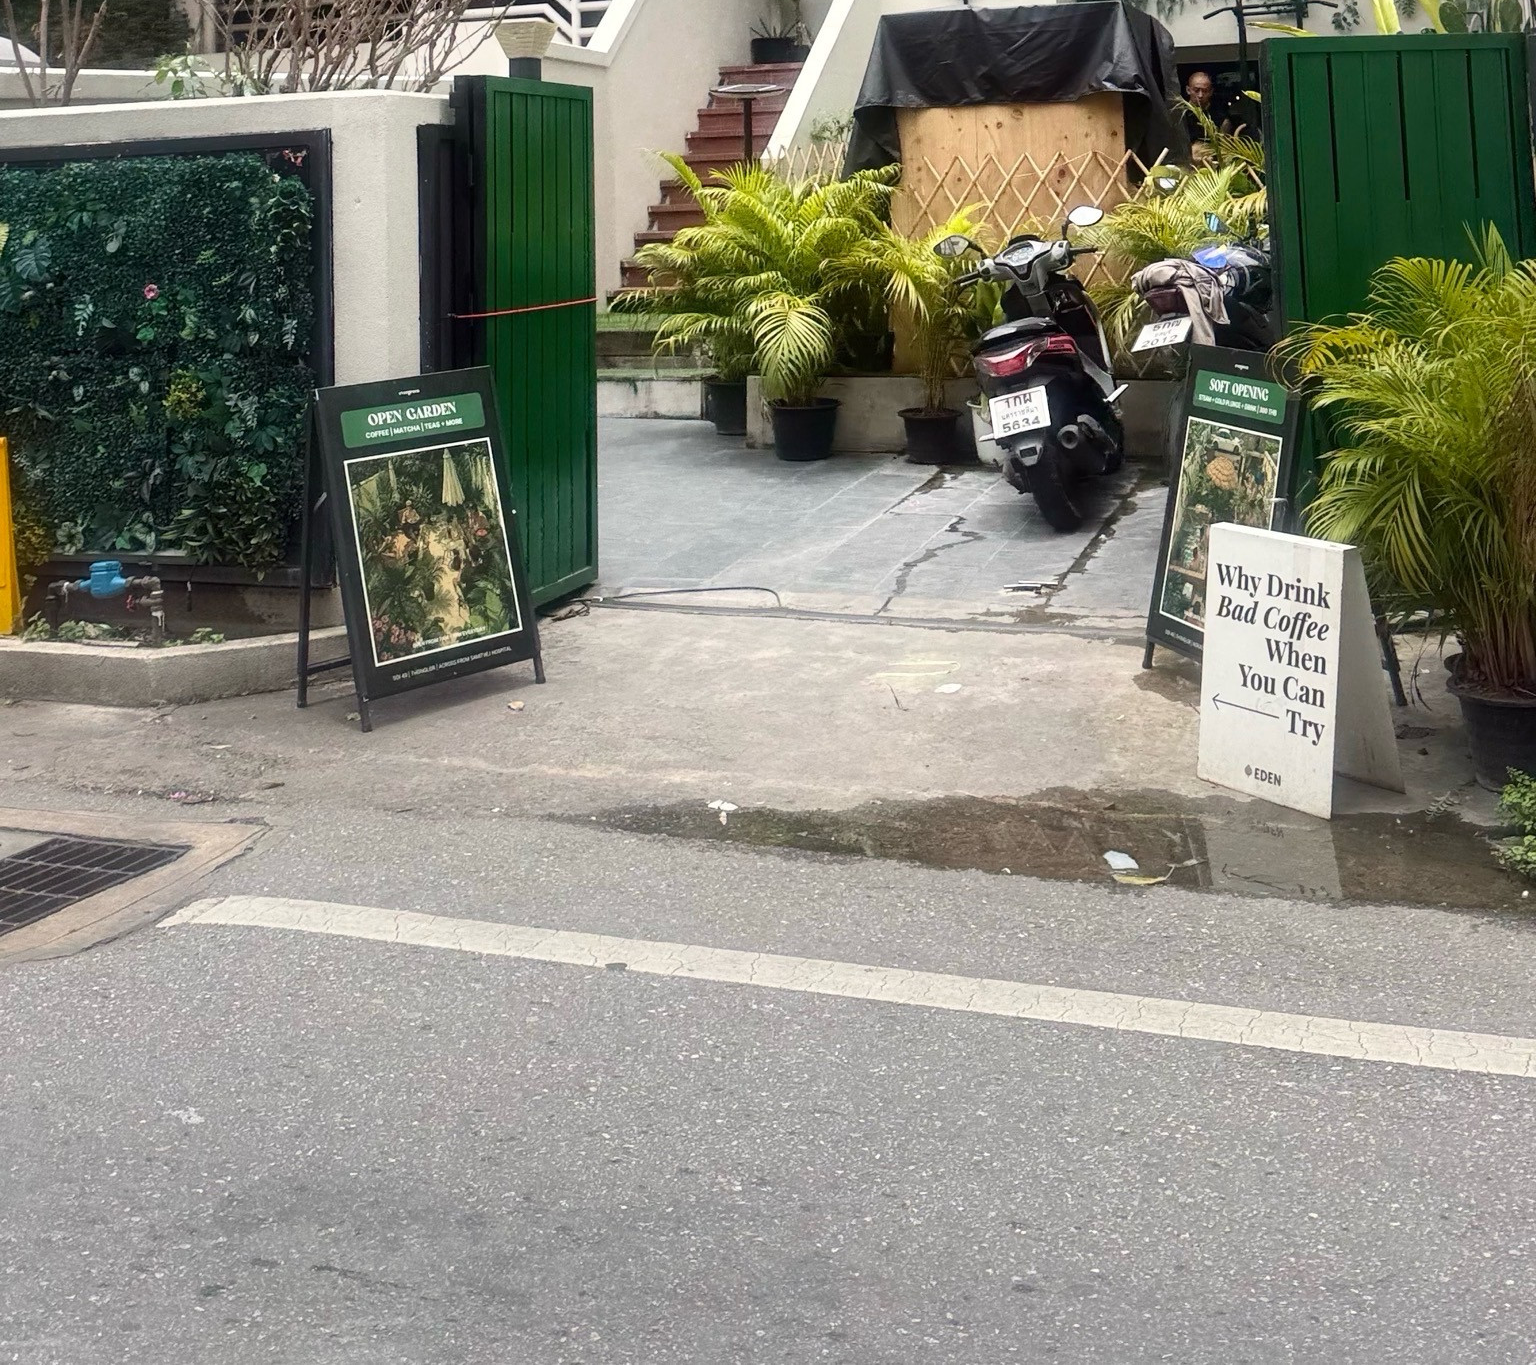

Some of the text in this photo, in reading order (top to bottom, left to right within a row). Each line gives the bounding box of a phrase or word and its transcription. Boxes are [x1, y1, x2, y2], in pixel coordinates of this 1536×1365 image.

[1141, 335, 1178, 348] 2012
[1209, 378, 1269, 402] SOFT OPENING
[367, 401, 457, 426] OPEN GARDEN
[1002, 415, 1041, 433] 5634
[365, 428, 390, 439] COFFEE
[393, 424, 421, 435] MATCHA
[424, 421, 441, 430] TEAS
[446, 418, 464, 426] MORE
[1216, 563, 1331, 609] Why Drink
[1216, 595, 1330, 641] Bad Coffee
[1265, 637, 1327, 676] When
[1238, 663, 1326, 708] You Can
[1286, 708, 1326, 746] Try
[1254, 767, 1282, 787] EDEN
